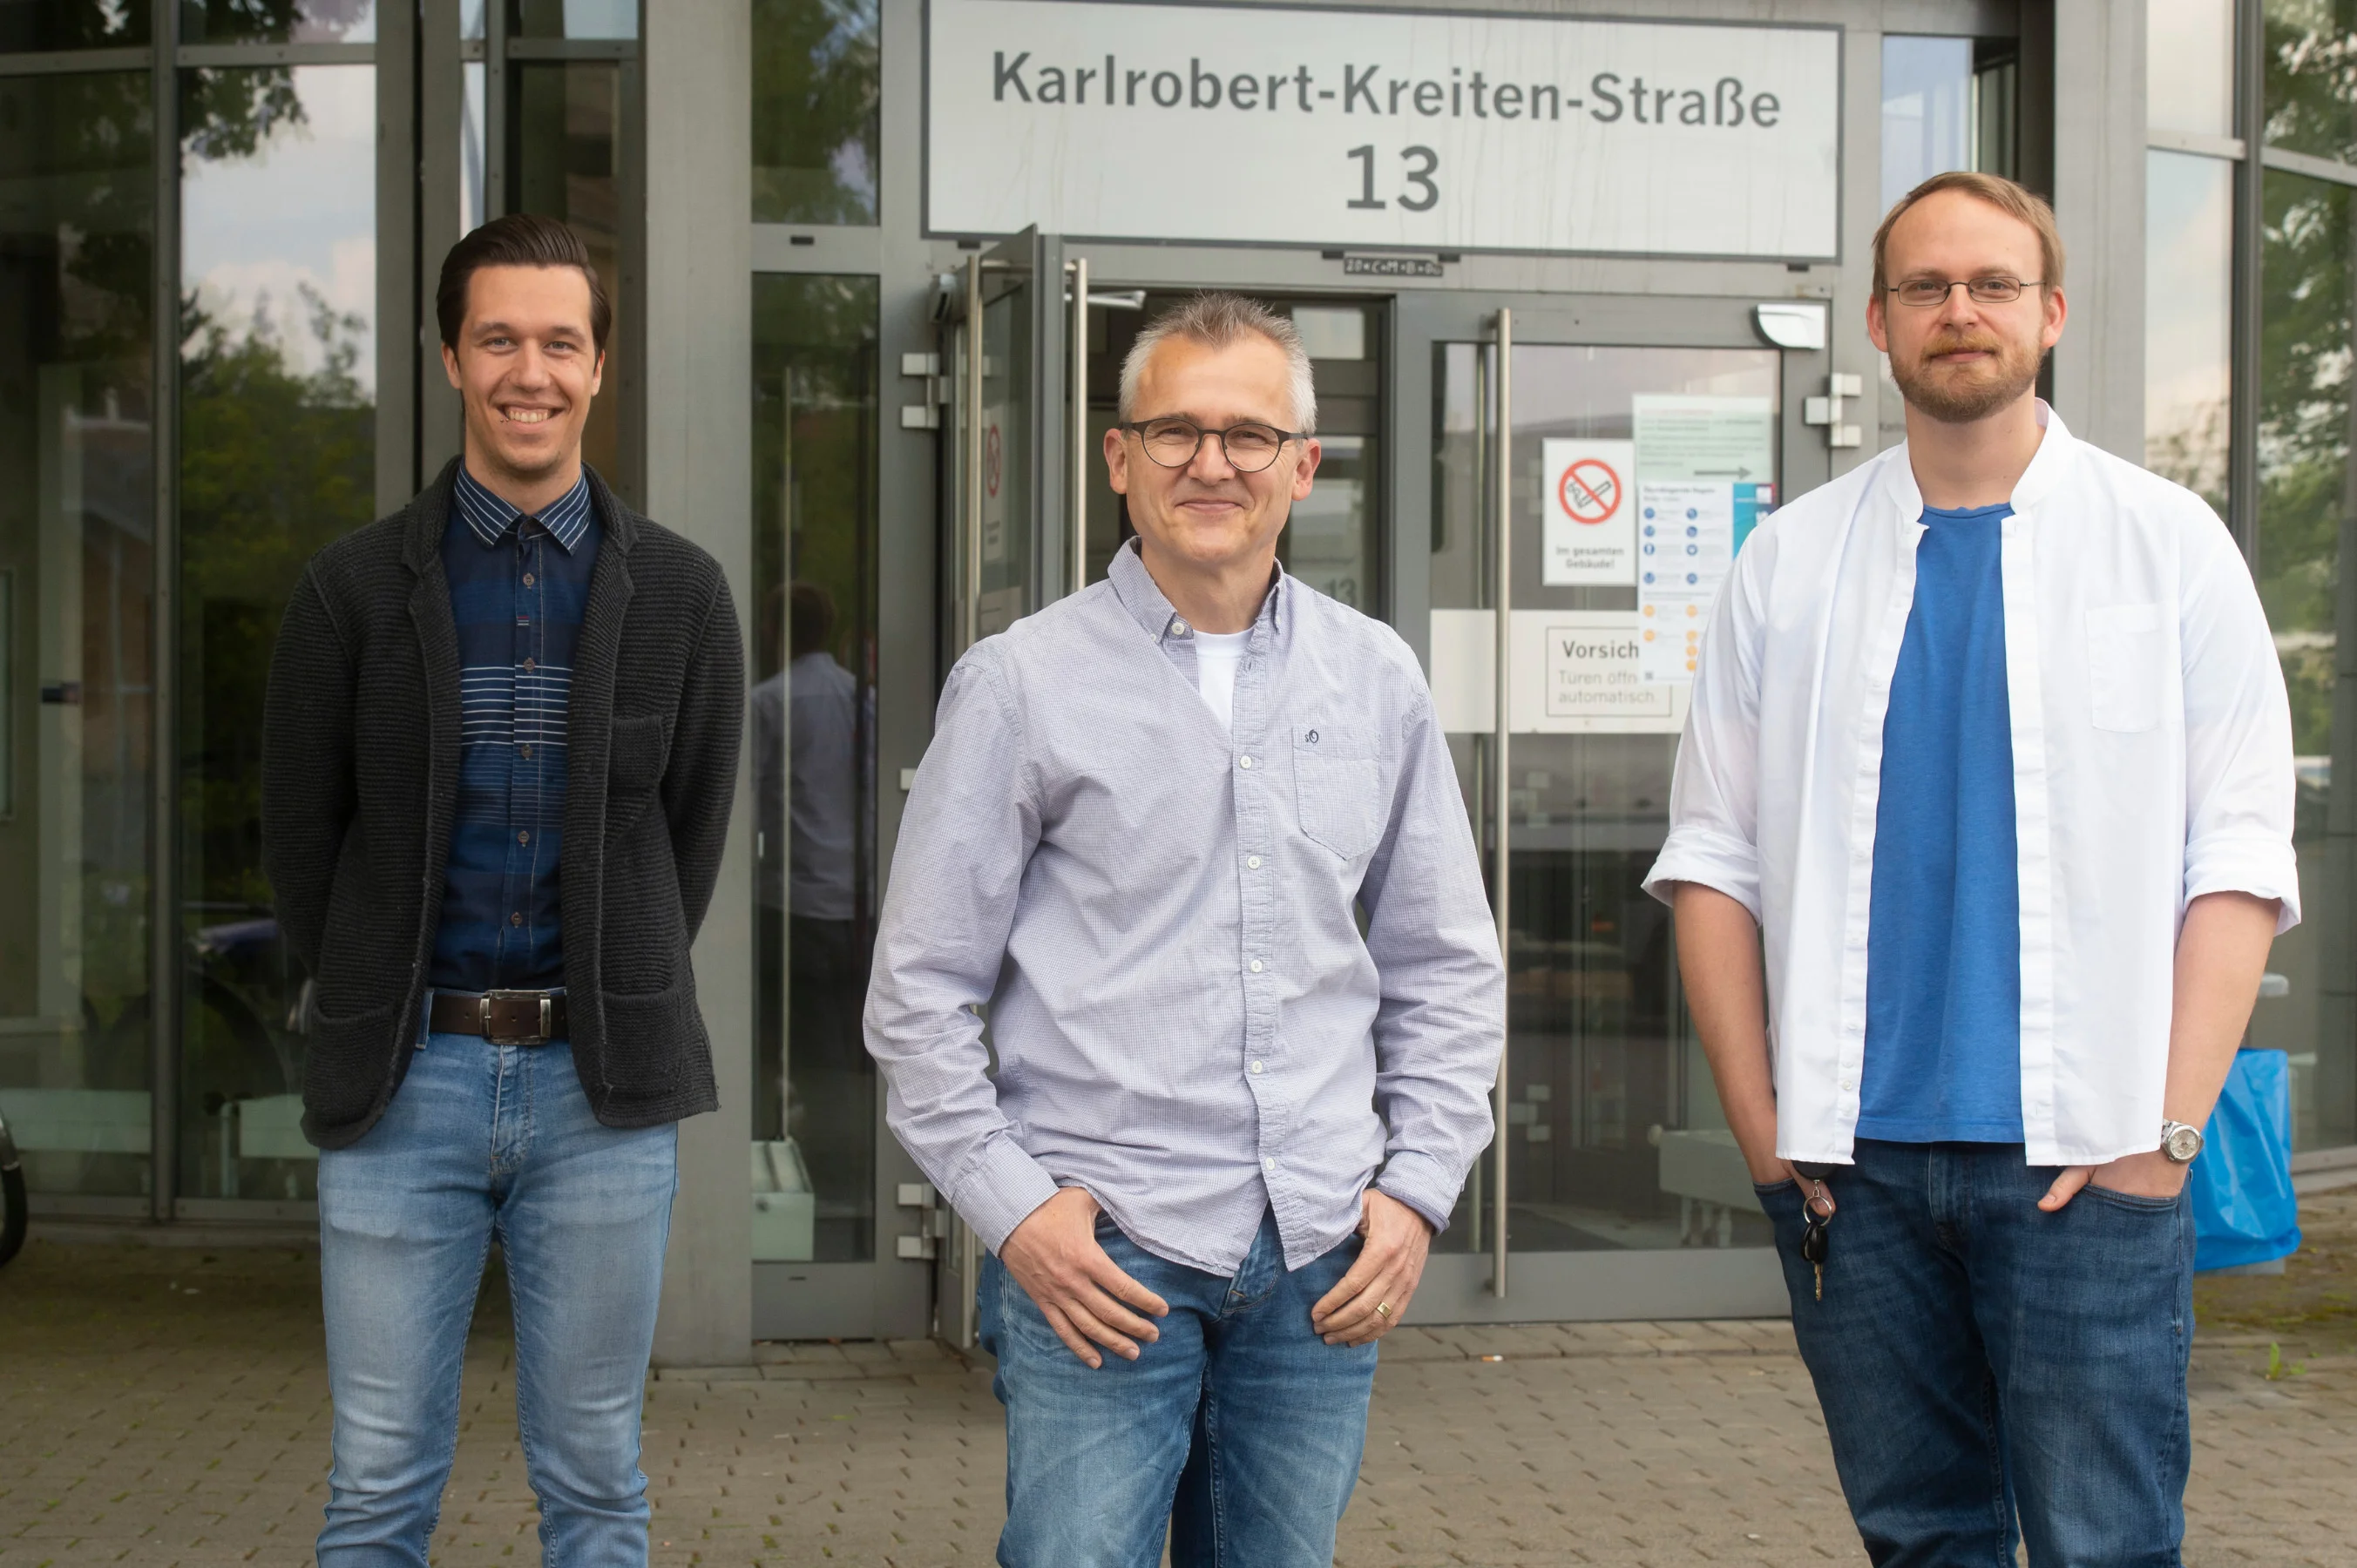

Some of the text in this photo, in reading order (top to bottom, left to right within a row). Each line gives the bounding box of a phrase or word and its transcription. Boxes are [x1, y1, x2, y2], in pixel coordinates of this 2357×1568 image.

[992, 51, 1781, 128] Karlrobert-Kreiten-Straße
[1346, 145, 1439, 212] 13
[1572, 545, 1625, 558] gesamten
[1561, 639, 1639, 659] Vorsich
[1607, 668, 1638, 686] öffn
